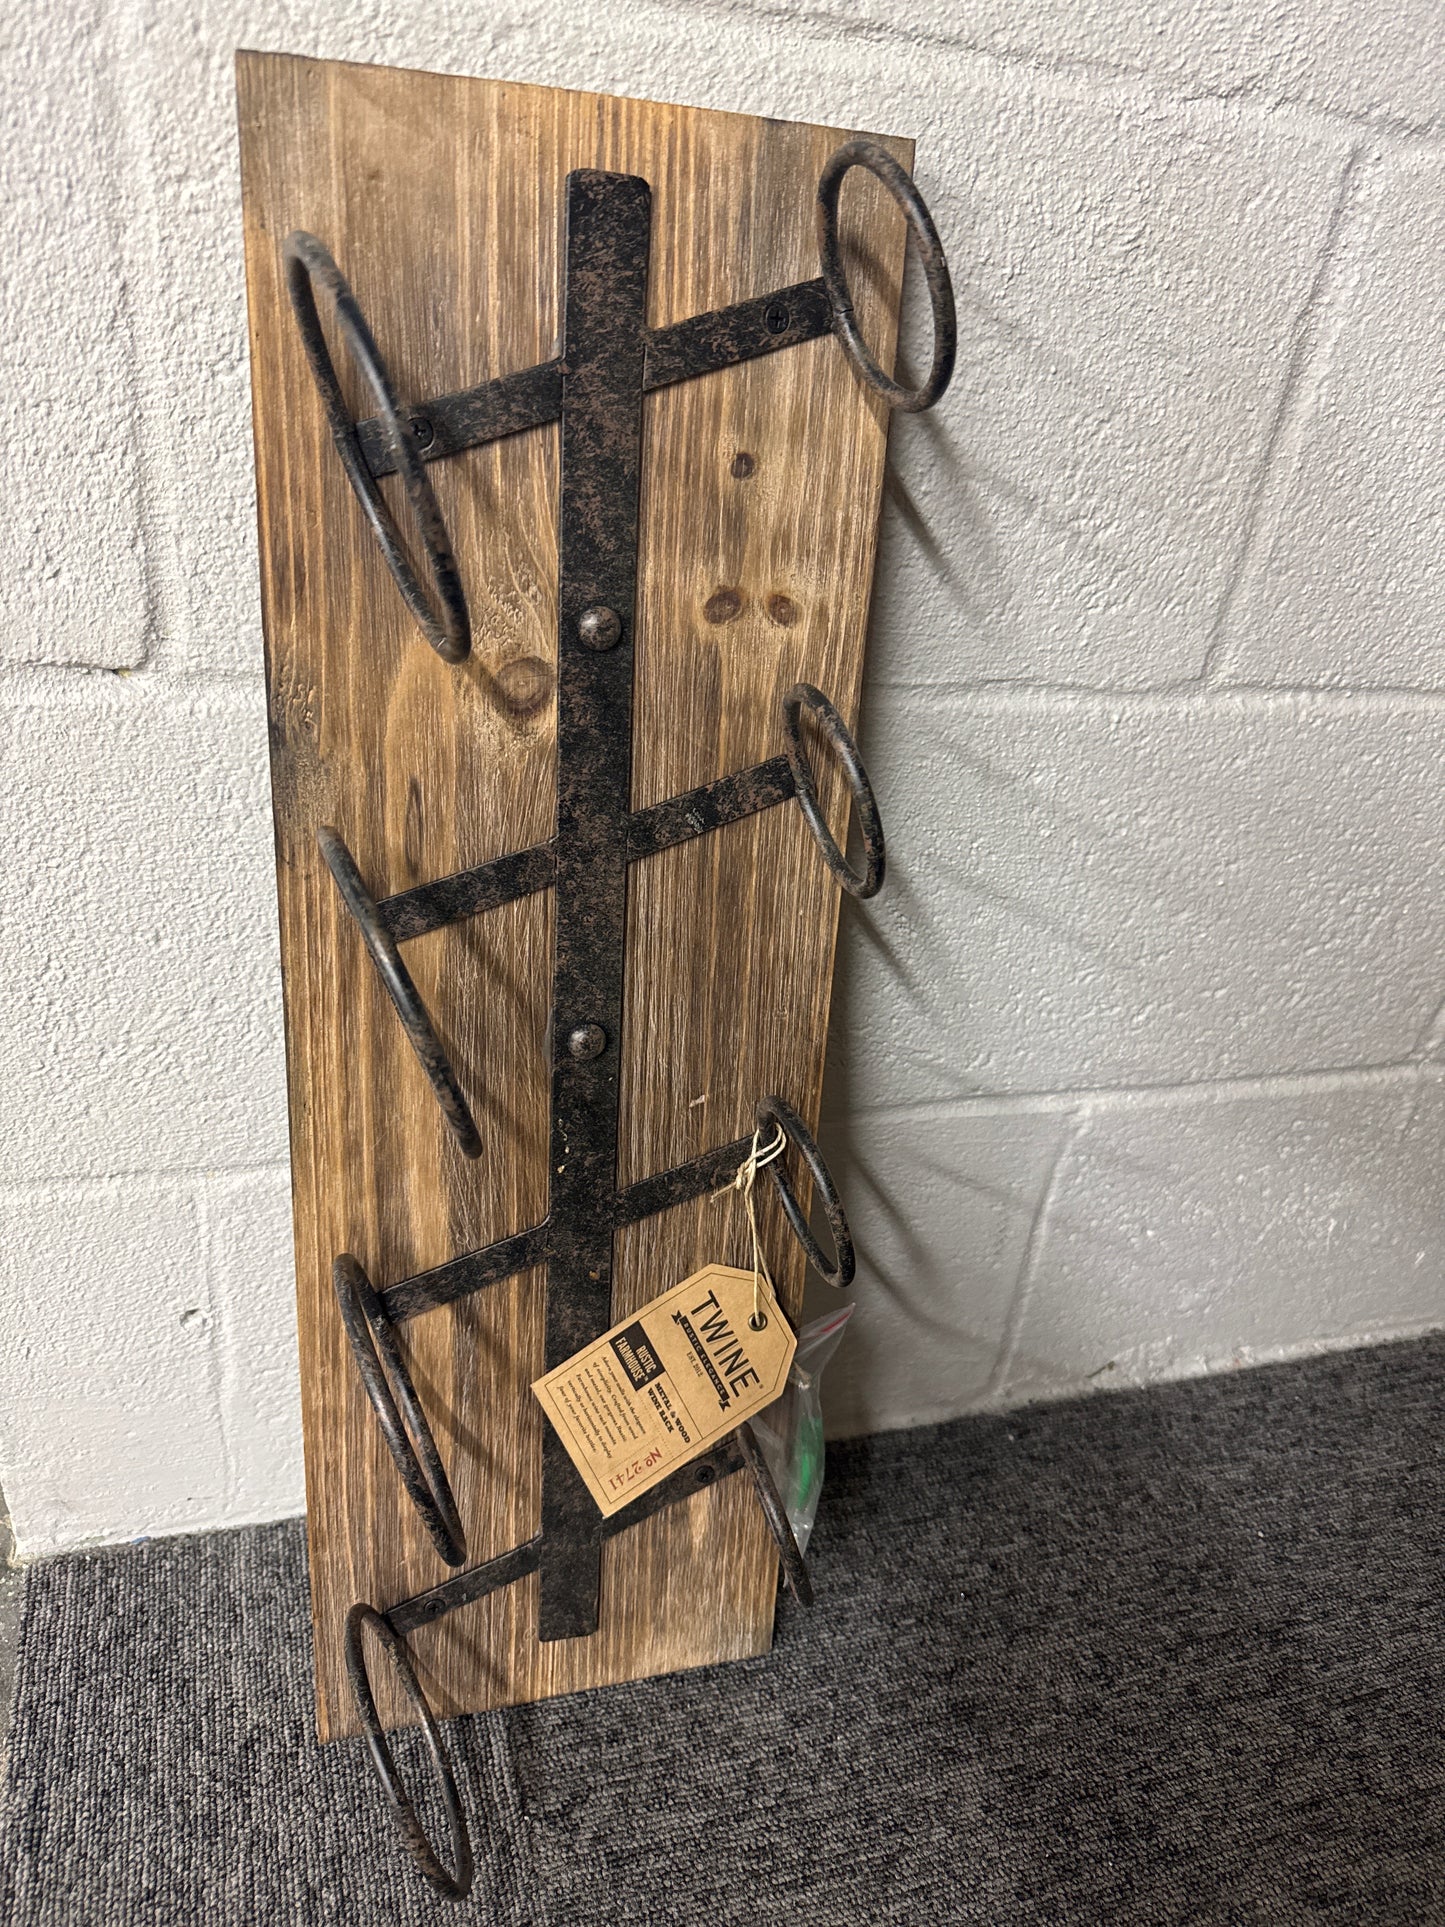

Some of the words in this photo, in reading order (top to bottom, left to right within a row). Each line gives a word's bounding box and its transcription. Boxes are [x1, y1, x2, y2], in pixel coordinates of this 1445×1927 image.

[584, 1367, 593, 1378] and
[635, 1344, 656, 1373] RUSTIC
[683, 1322, 701, 1351] RUSTIC
[700, 1353, 725, 1394] ELEGANCE
[692, 1363, 703, 1377] 2012
[647, 1387, 662, 1410] WINE
[658, 1409, 674, 1433] RACK
[654, 1381, 671, 1410] METAL
[669, 1410, 675, 1418] &
[674, 1417, 690, 1443] WOOD
[607, 1460, 643, 1490] 2741
